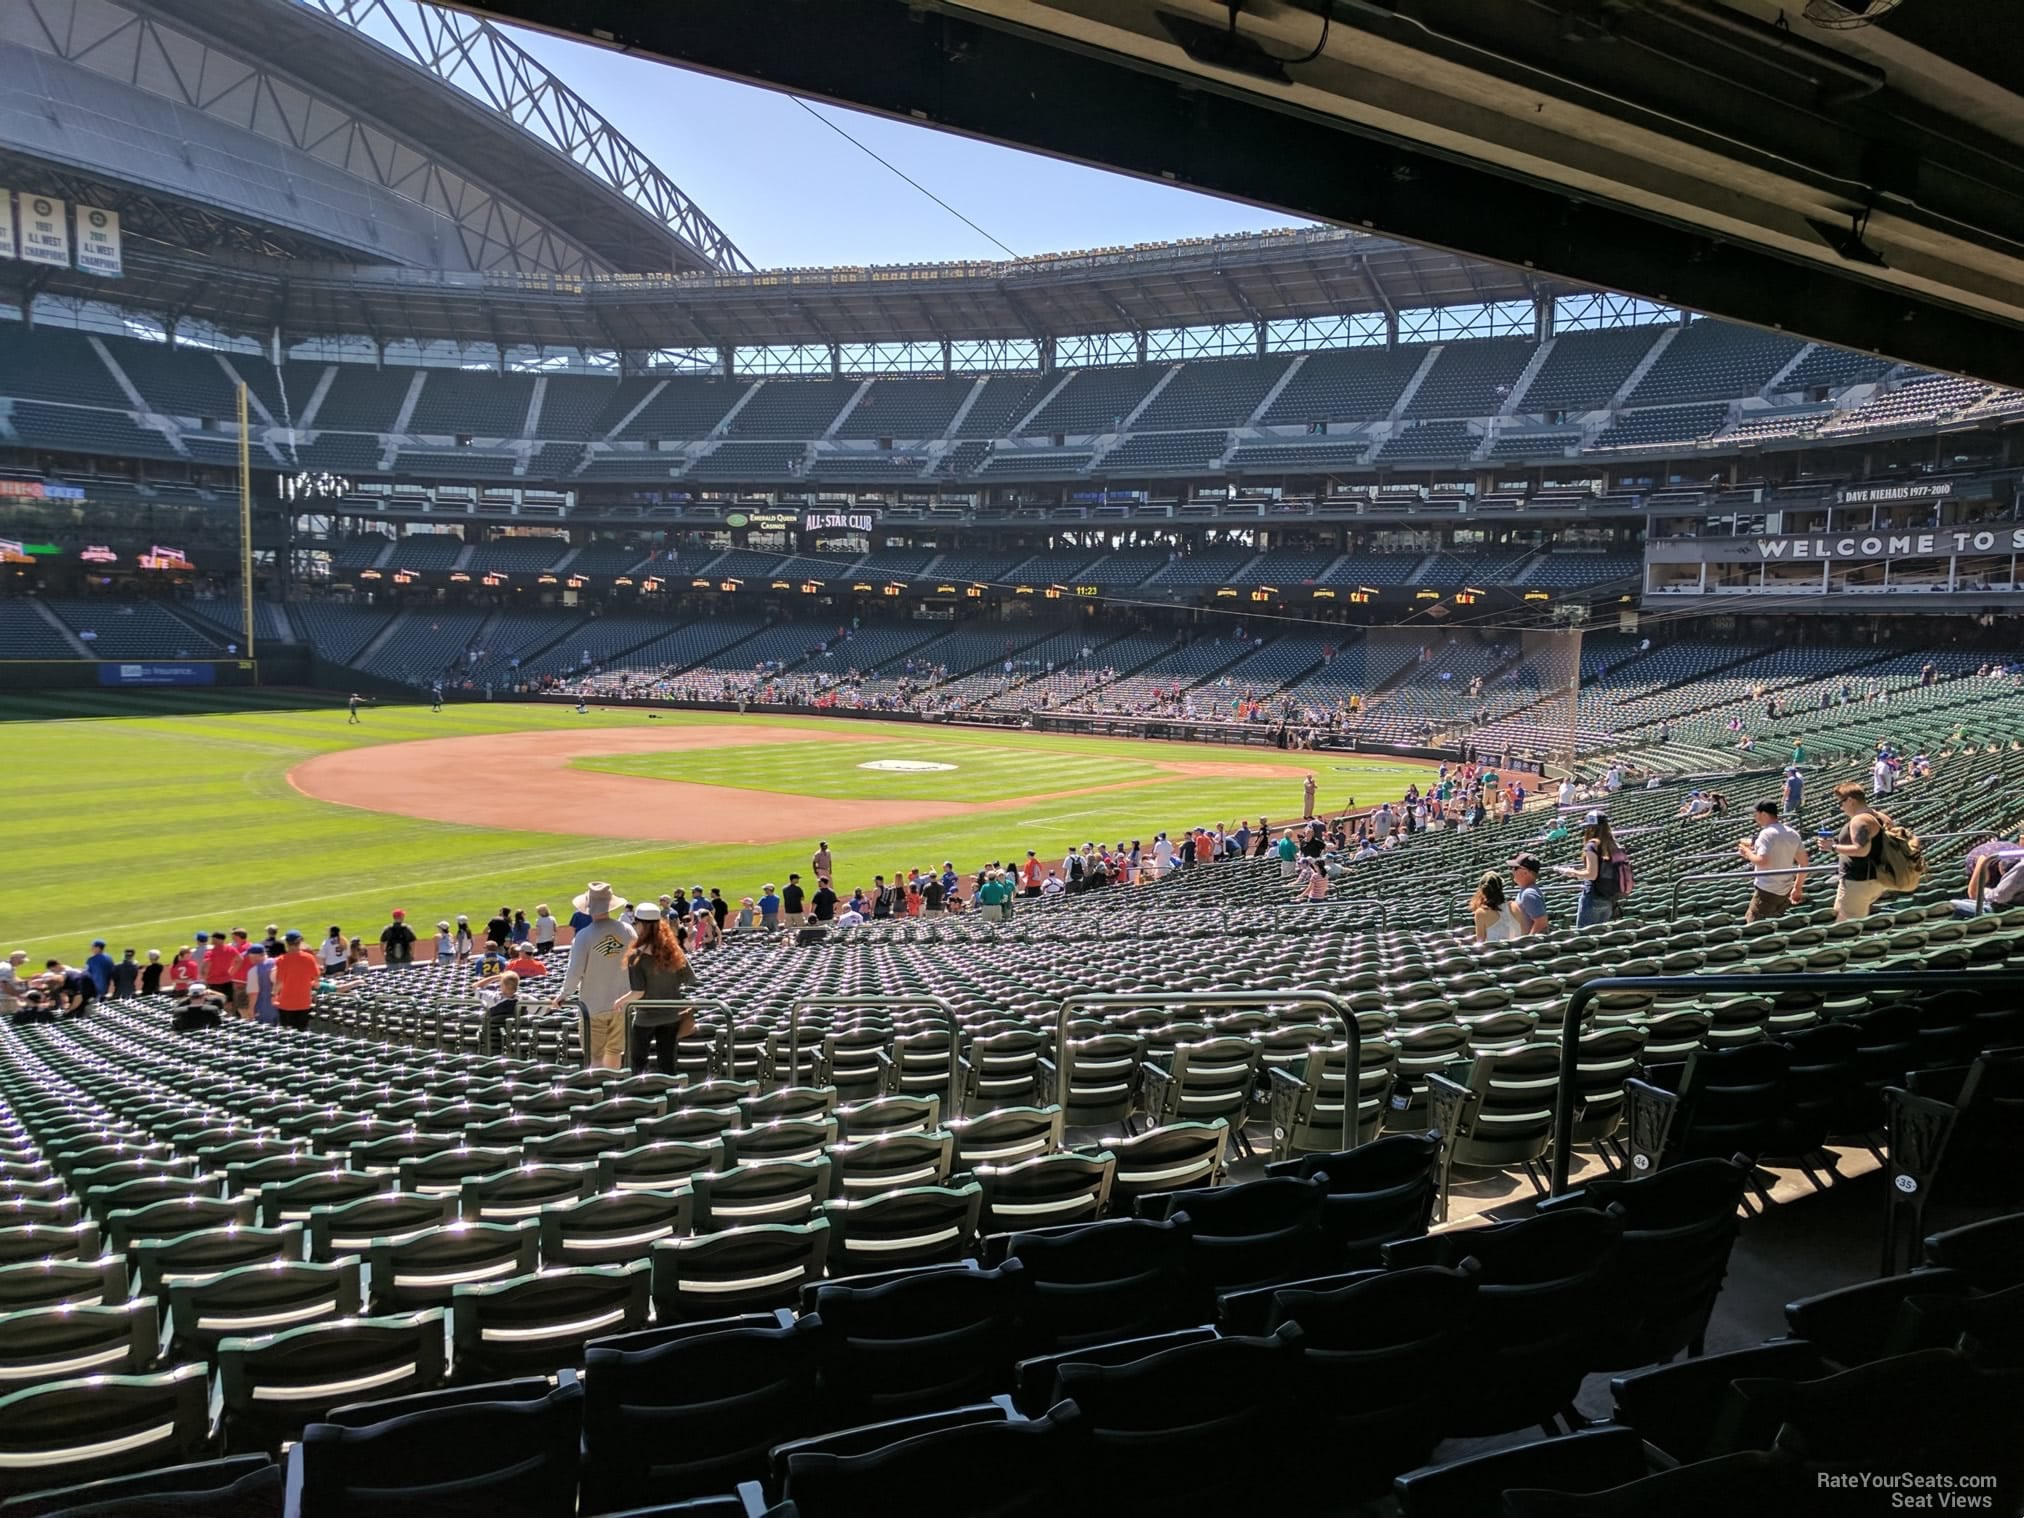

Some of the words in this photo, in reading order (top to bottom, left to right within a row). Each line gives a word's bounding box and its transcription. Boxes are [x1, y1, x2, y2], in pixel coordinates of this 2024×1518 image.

[41, 235, 61, 247] WEST
[24, 246, 66, 262] CHAMPIONS
[96, 245, 114, 256] WEST
[80, 255, 120, 270] CHAMPIONS
[1846, 491, 1868, 502] DAVE
[1870, 487, 1908, 500] NIEHAUS
[1910, 484, 1950, 497] 1977-2010
[849, 515, 872, 532] CLUB
[1758, 535, 1934, 558] WELCOME
[1953, 531, 1995, 551] TO
[1076, 586, 1097, 595] 11:23
[178, 966, 189, 979] 2
[482, 963, 500, 975] 24
[1899, 1178, 1912, 1189] 35
